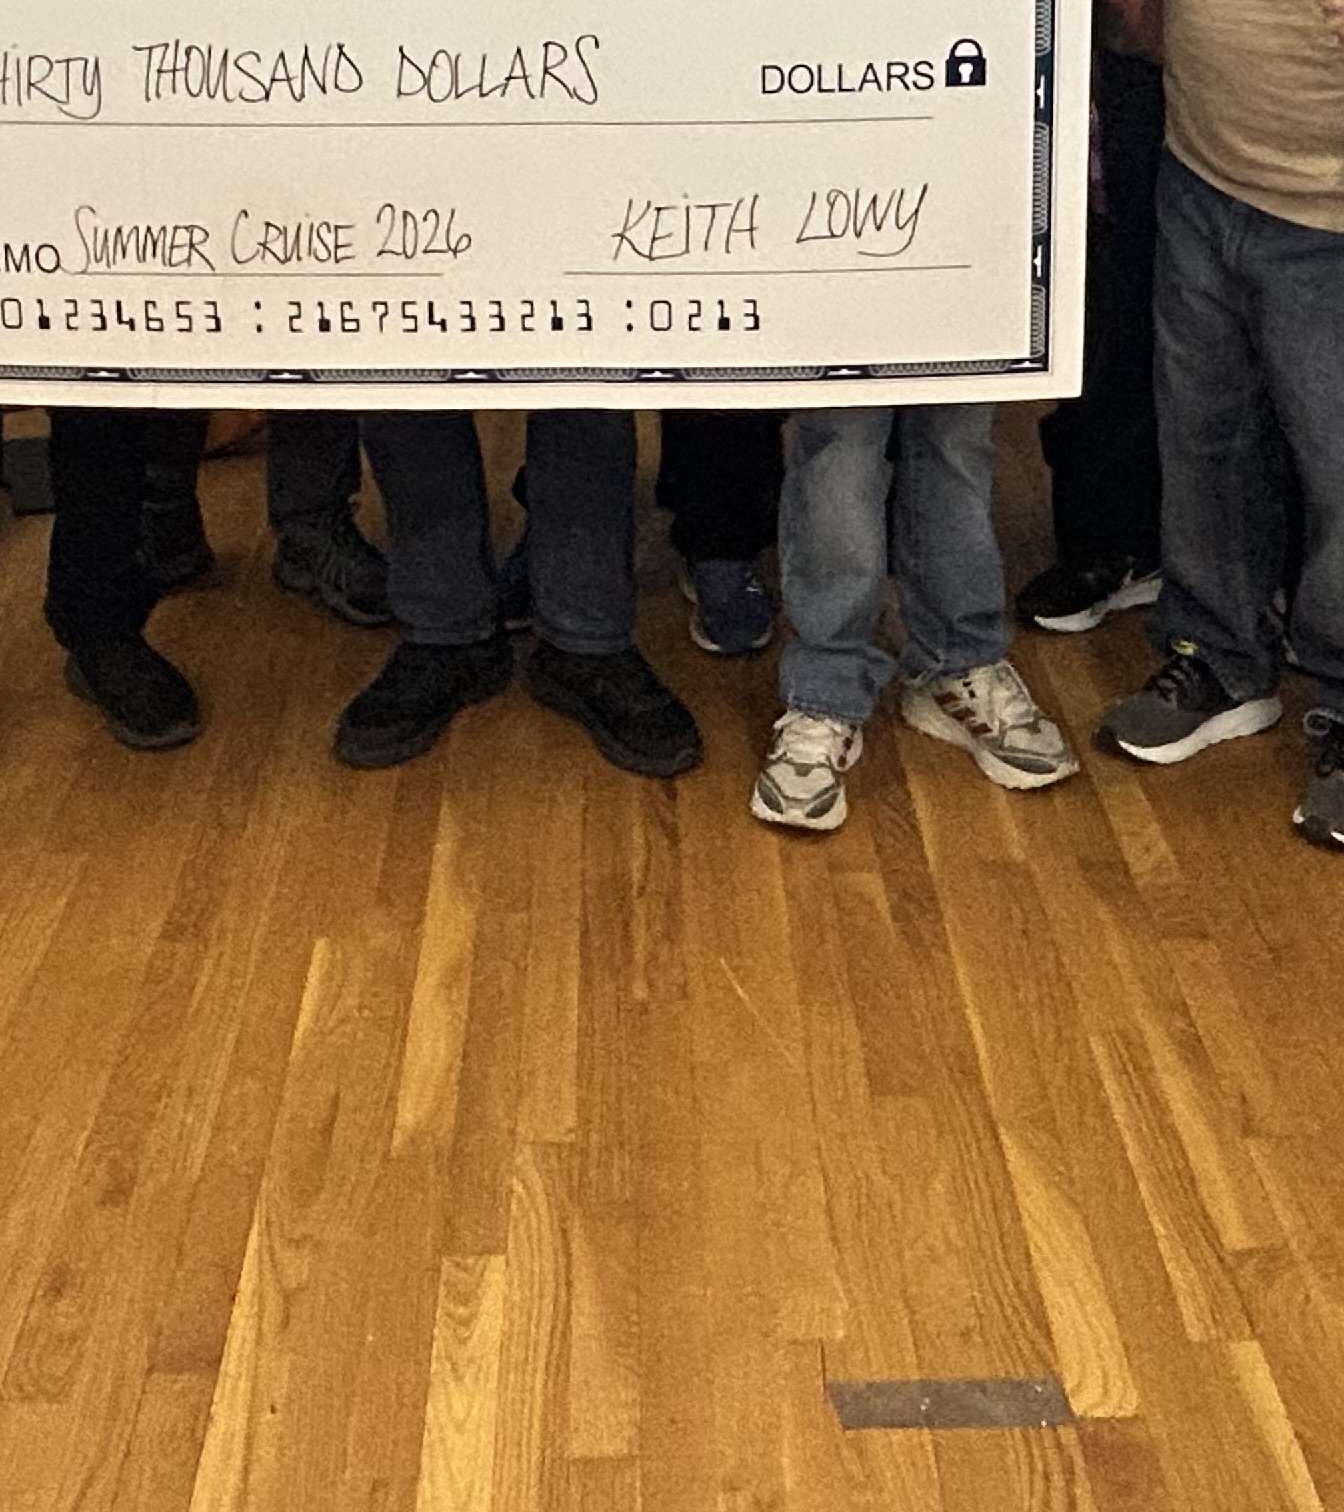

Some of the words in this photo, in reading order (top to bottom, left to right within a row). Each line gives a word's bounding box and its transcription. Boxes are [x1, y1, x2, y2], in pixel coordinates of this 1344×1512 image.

[131, 38, 364, 104] THOUSAND
[396, 34, 600, 105] DOLLARS
[760, 60, 936, 95] DOLLARS
[67, 205, 216, 274] SUMMER
[230, 209, 356, 266] CRUISE
[375, 202, 472, 260] 2026
[611, 192, 760, 262] KEITH
[794, 182, 929, 258] LOWY
